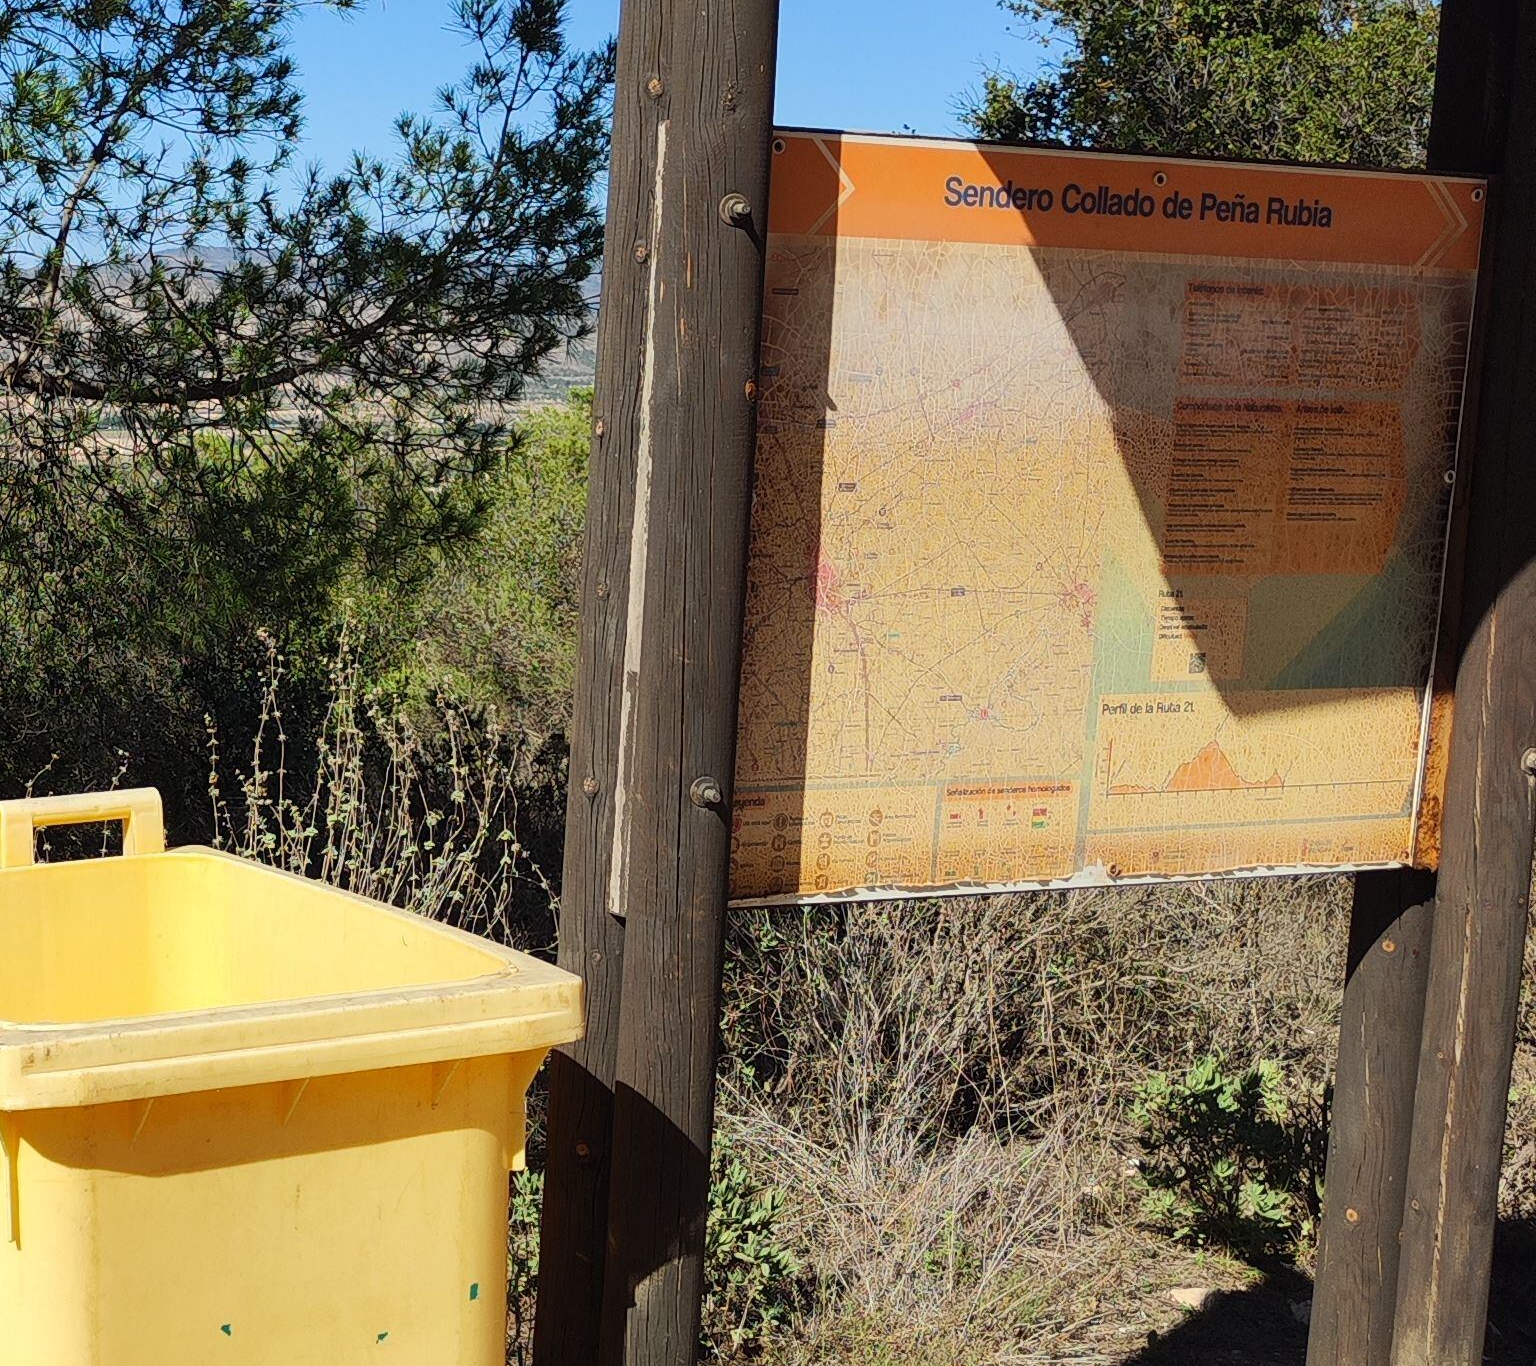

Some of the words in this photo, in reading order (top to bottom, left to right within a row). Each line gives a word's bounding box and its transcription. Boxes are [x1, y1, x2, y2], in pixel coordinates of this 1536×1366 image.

[944, 176, 1054, 212] Sendero
[1061, 183, 1155, 218] Collado
[1161, 190, 1193, 220] de
[1200, 192, 1260, 224] Peña
[1266, 196, 1333, 228] Rubia
[1158, 589, 1175, 598] Ruta
[1175, 589, 1183, 598] 21
[1101, 703, 1127, 715] Perfil
[1130, 703, 1143, 714] de
[1145, 702, 1153, 713] la
[1156, 701, 1181, 713] Ruta
[1184, 701, 1195, 712] 21
[987, 786, 996, 795] de
[733, 797, 766, 812] eyenda
